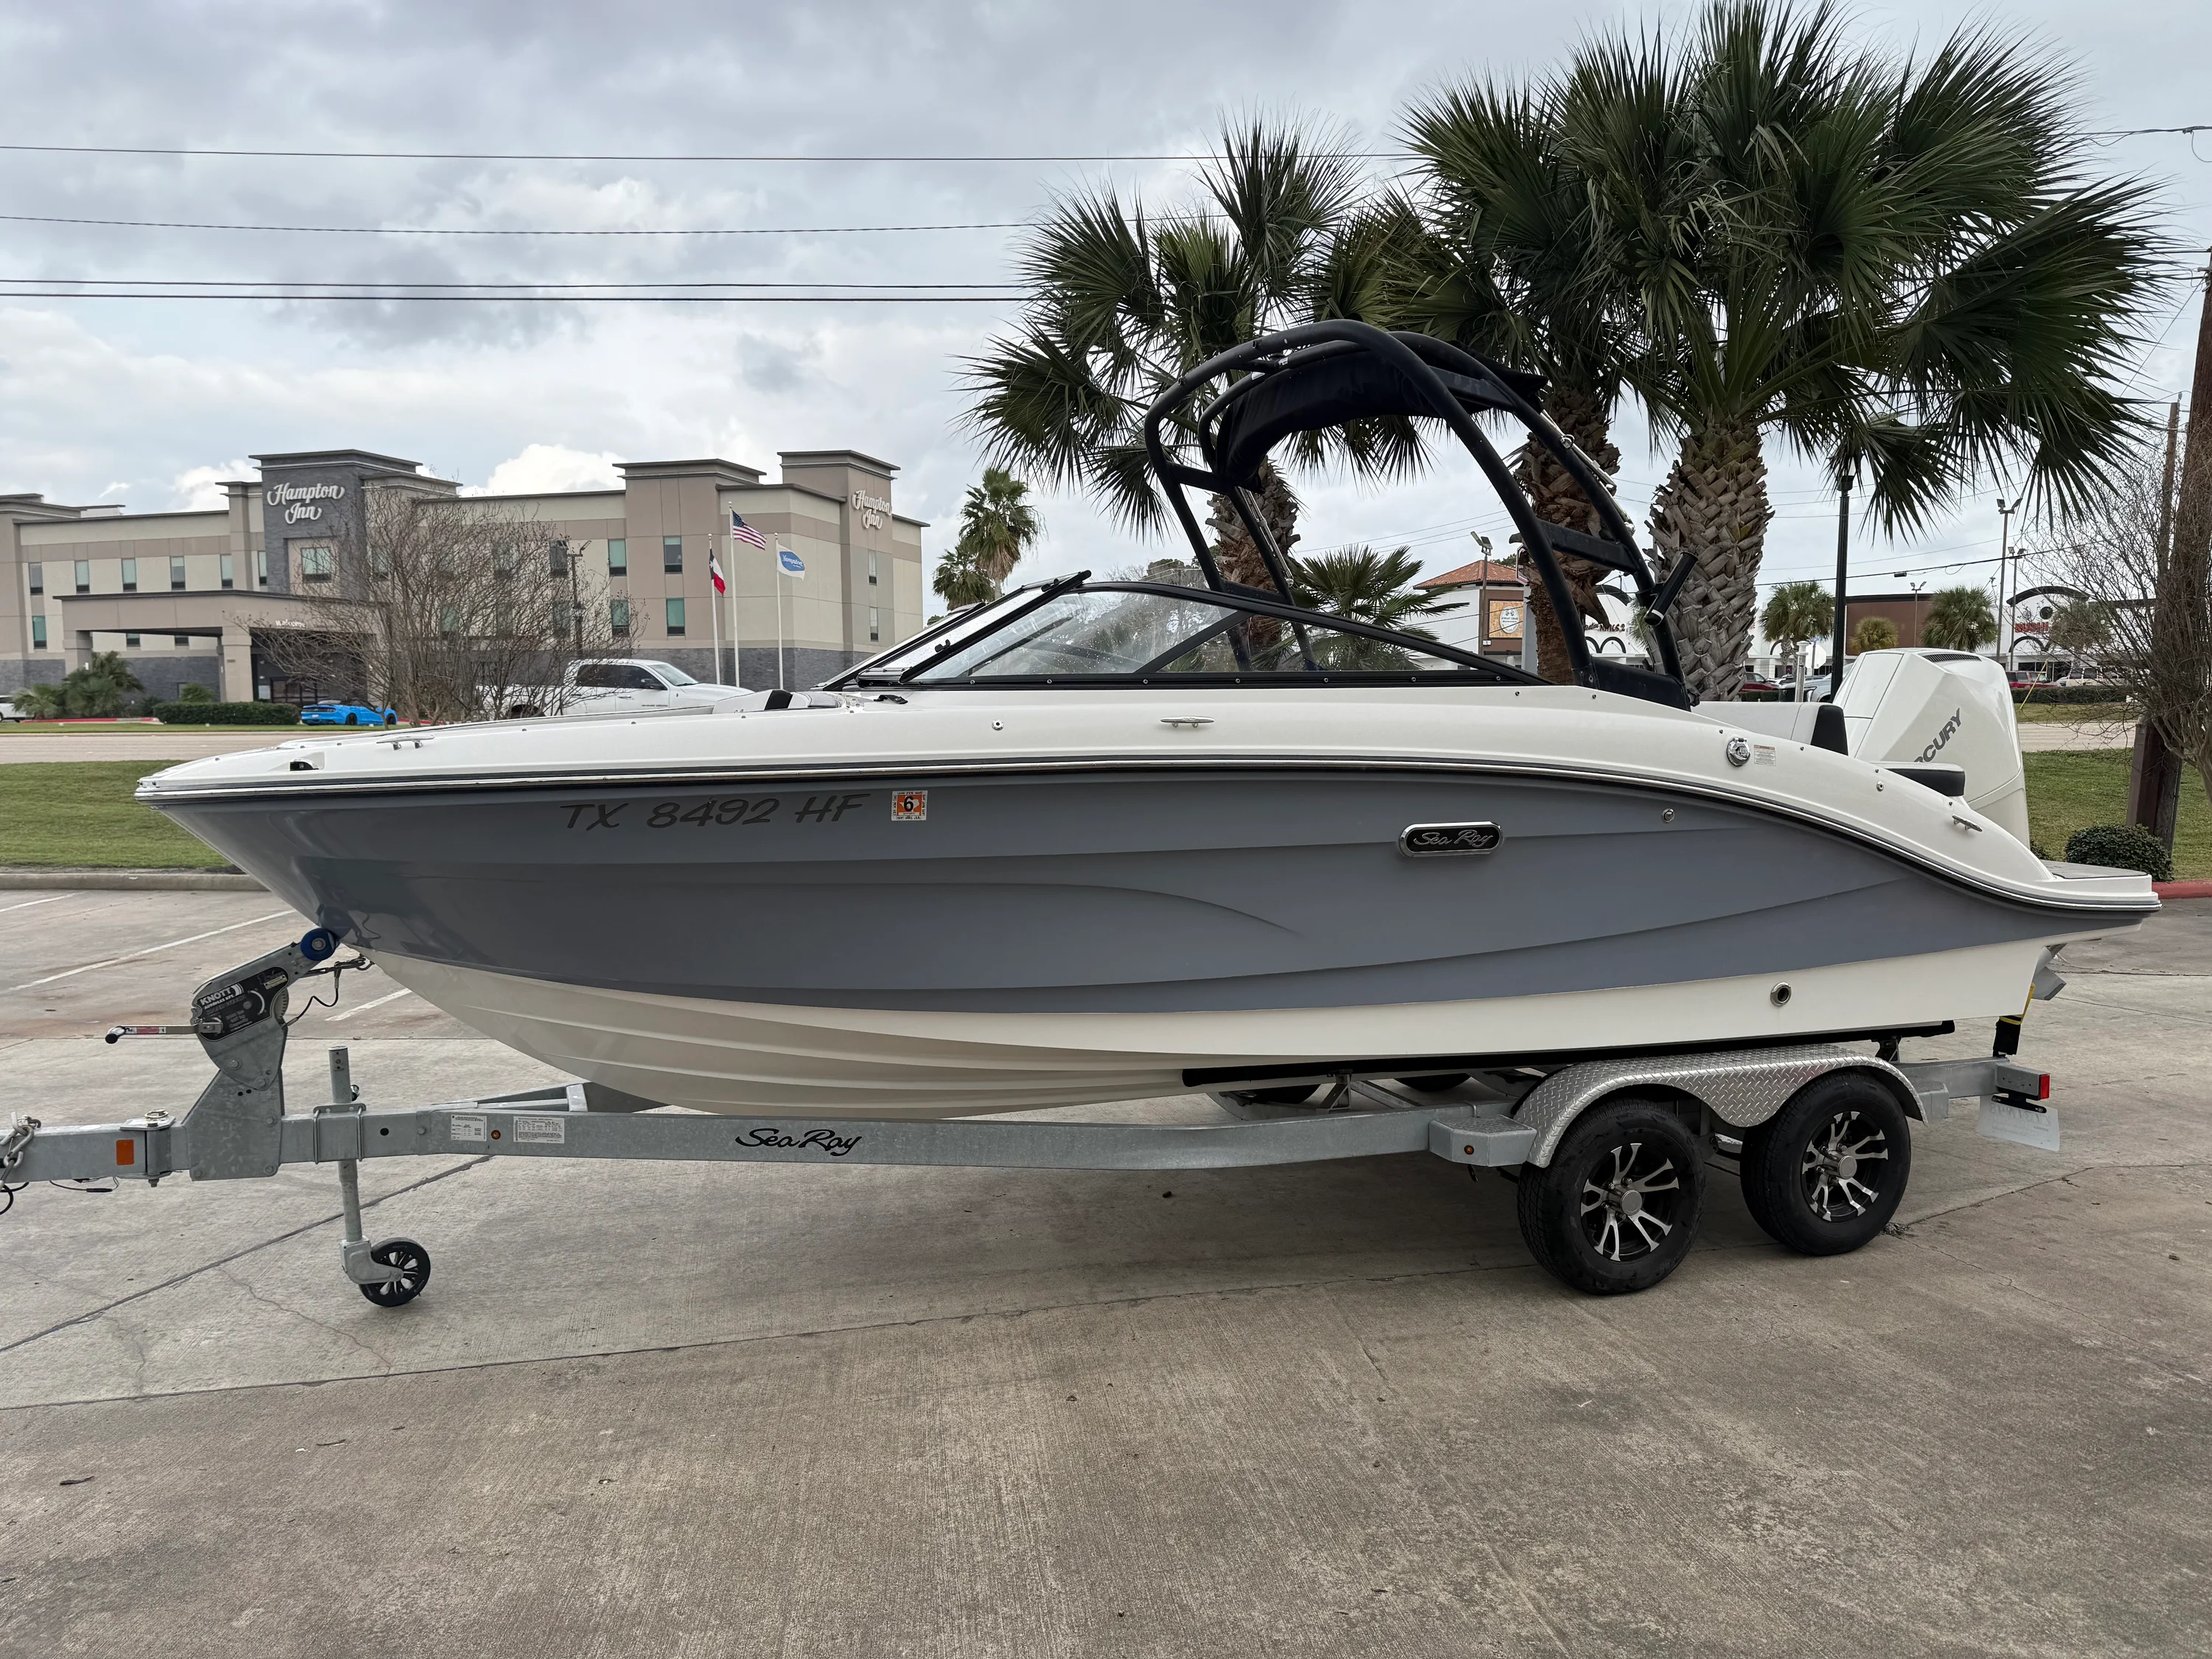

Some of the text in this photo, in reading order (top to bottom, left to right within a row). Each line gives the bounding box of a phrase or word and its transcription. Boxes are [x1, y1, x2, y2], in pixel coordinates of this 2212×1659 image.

[267, 482, 345, 506] Hampton
[852, 490, 892, 516] Hampton
[285, 502, 322, 524] Inn
[862, 509, 883, 529] Inn
[559, 801, 629, 832] TX
[646, 798, 780, 828] 8492
[794, 793, 872, 824] HF
[904, 796, 914, 813] 6
[1413, 829, 1494, 848] Sea Ray
[200, 987, 232, 1006] KNOTT
[735, 1128, 863, 1157] Sea Ray
